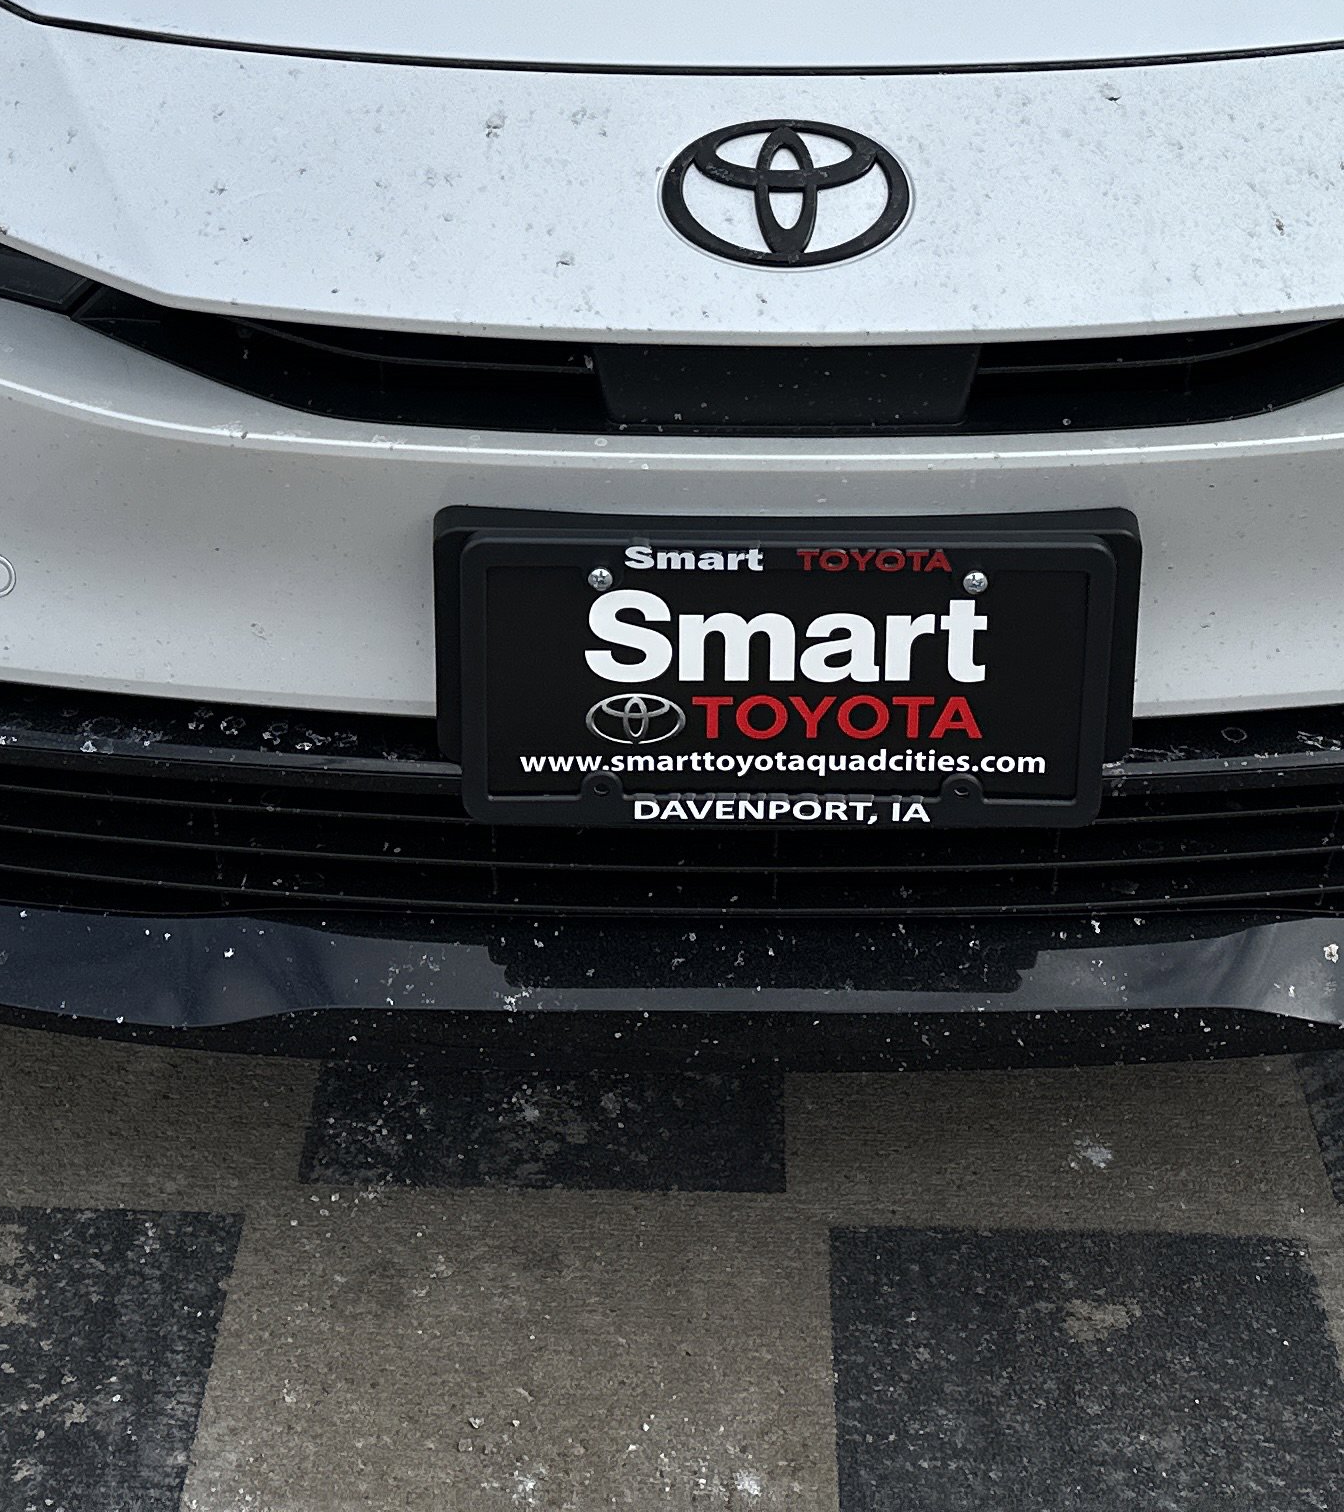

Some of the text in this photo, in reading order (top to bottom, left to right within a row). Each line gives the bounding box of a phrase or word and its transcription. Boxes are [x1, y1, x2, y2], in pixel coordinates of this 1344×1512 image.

[624, 545, 952, 572] Smart TOYOTA
[585, 590, 988, 683] Smart
[692, 694, 983, 740] TOYOTA
[519, 748, 1046, 777] www.smarttoyotaquadcities.com
[634, 800, 931, 825] DAVENPORT, IA
